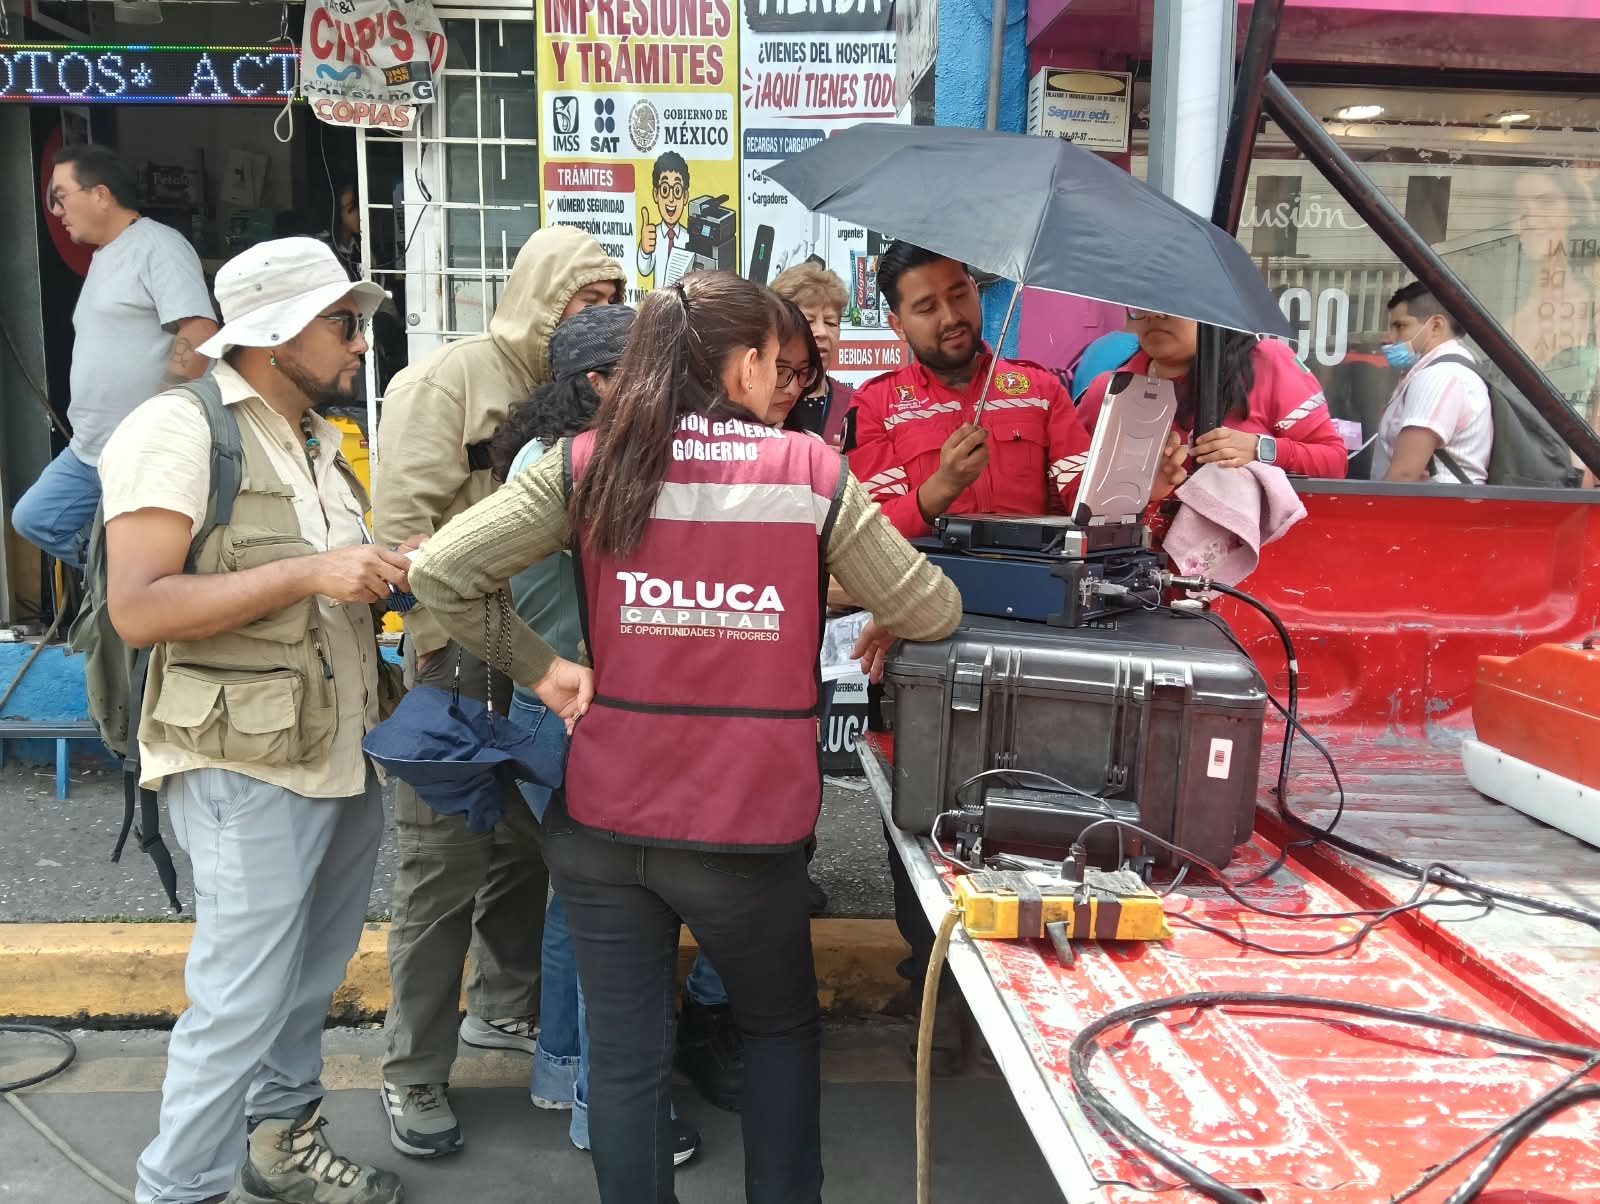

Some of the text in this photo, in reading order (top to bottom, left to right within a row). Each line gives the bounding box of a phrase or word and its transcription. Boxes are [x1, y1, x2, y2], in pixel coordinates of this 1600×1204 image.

[543, 0, 731, 37] IMPRESIONES
[552, 36, 725, 86] Y TRÁMITES
[758, 42, 806, 64] ¿VIENES
[810, 43, 832, 63] DEL
[755, 66, 802, 110] ¡AQUÍ
[805, 73, 858, 109] TIENES
[314, 98, 409, 127] COPIAS
[664, 109, 727, 120] GOBIERNO DE
[553, 135, 580, 152] IMSS
[664, 122, 728, 145] MÉXICO
[591, 136, 620, 153] SAT
[746, 137, 778, 153] RECARGAS
[779, 137, 784, 153] Y
[558, 165, 614, 187] TRÁMITES
[557, 196, 625, 213] NÚMERO SEGURIDAD
[752, 192, 788, 207] Cargadores
[602, 221, 634, 236] CARTILLA
[837, 227, 864, 241] urgentes
[628, 289, 634, 303] Y
[838, 344, 901, 365] BEBIDAS Y MÁS
[712, 418, 787, 439] GENERAL
[672, 438, 758, 461] GOBIERNO
[616, 571, 785, 612] TOLUCA
[625, 608, 776, 629] CAPITAL
[620, 625, 780, 642] DE OPORTUNIDADES Y PROGRESO
